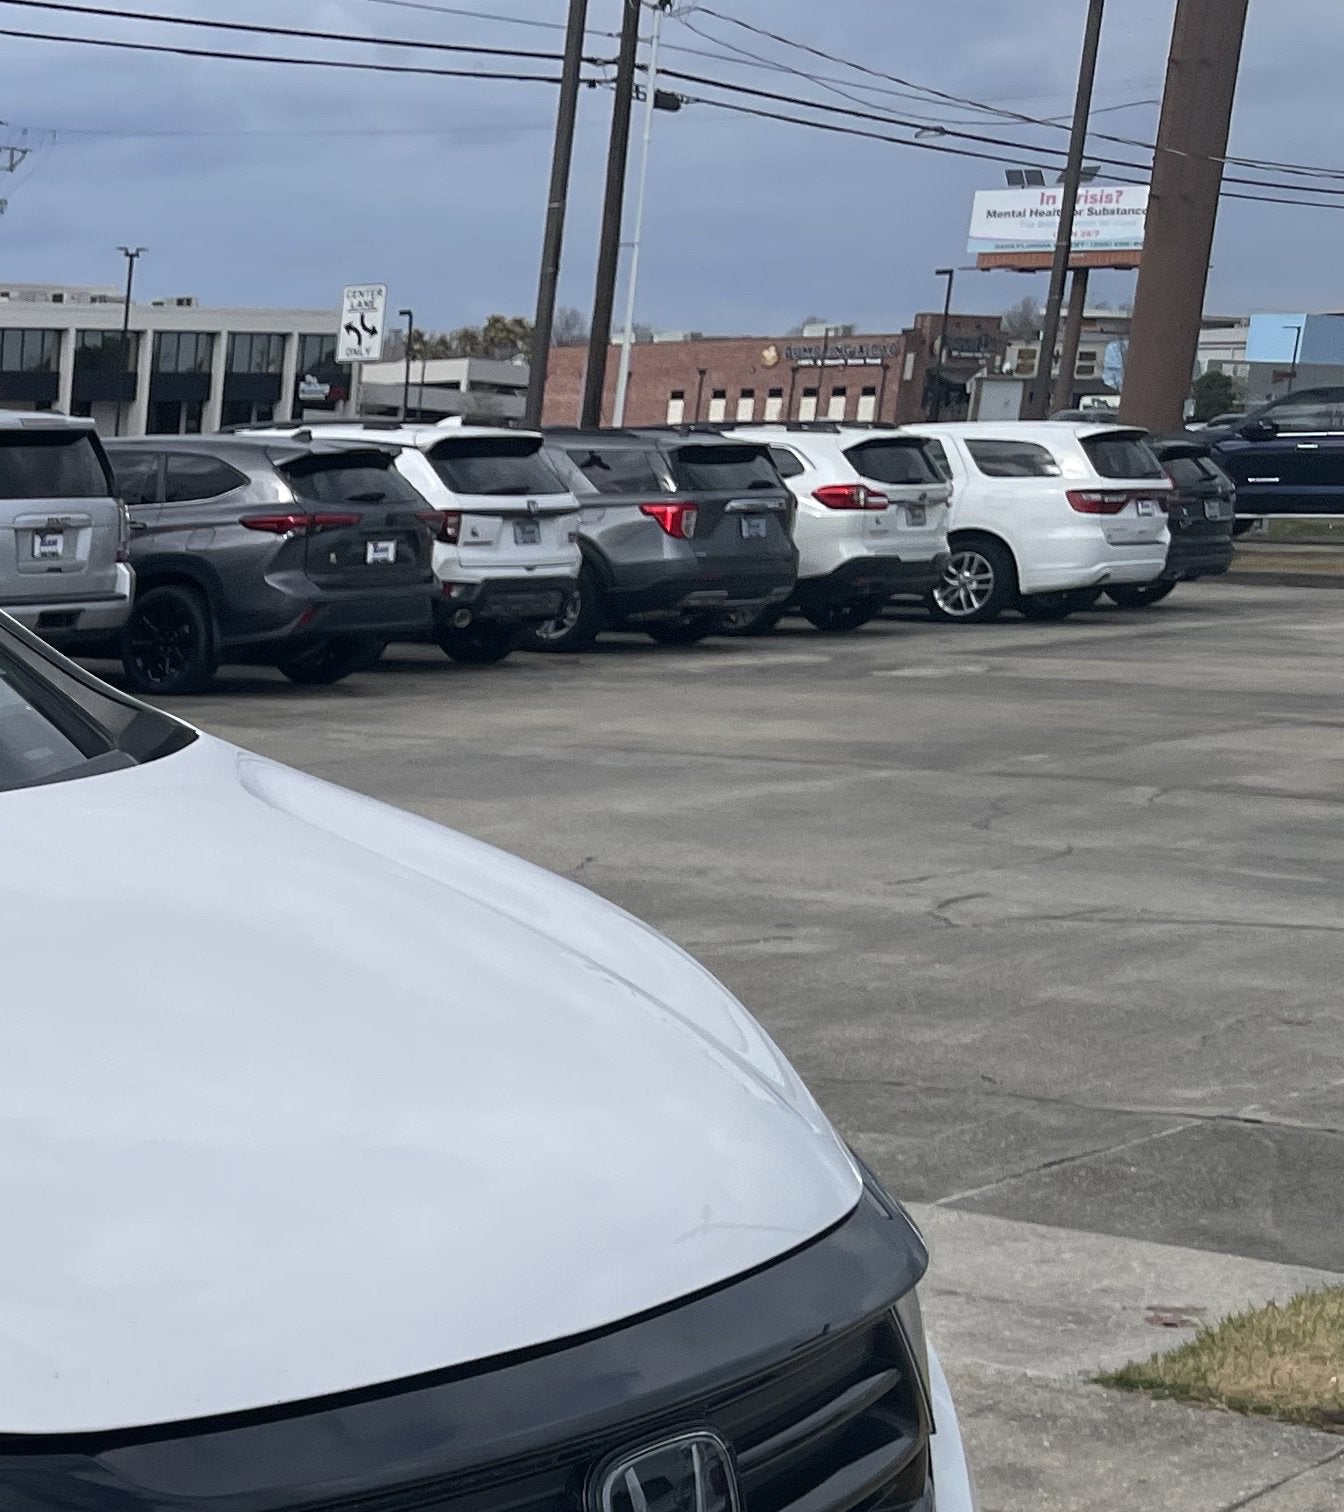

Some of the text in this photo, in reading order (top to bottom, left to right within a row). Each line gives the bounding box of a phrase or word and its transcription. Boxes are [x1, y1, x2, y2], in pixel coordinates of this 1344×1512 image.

[1039, 189, 1124, 206] In risis?
[986, 208, 1027, 219] Mental
[1030, 208, 1061, 218] Healt
[346, 288, 383, 299] CENTER
[350, 300, 374, 309] LANE
[345, 347, 370, 357] ONLY
